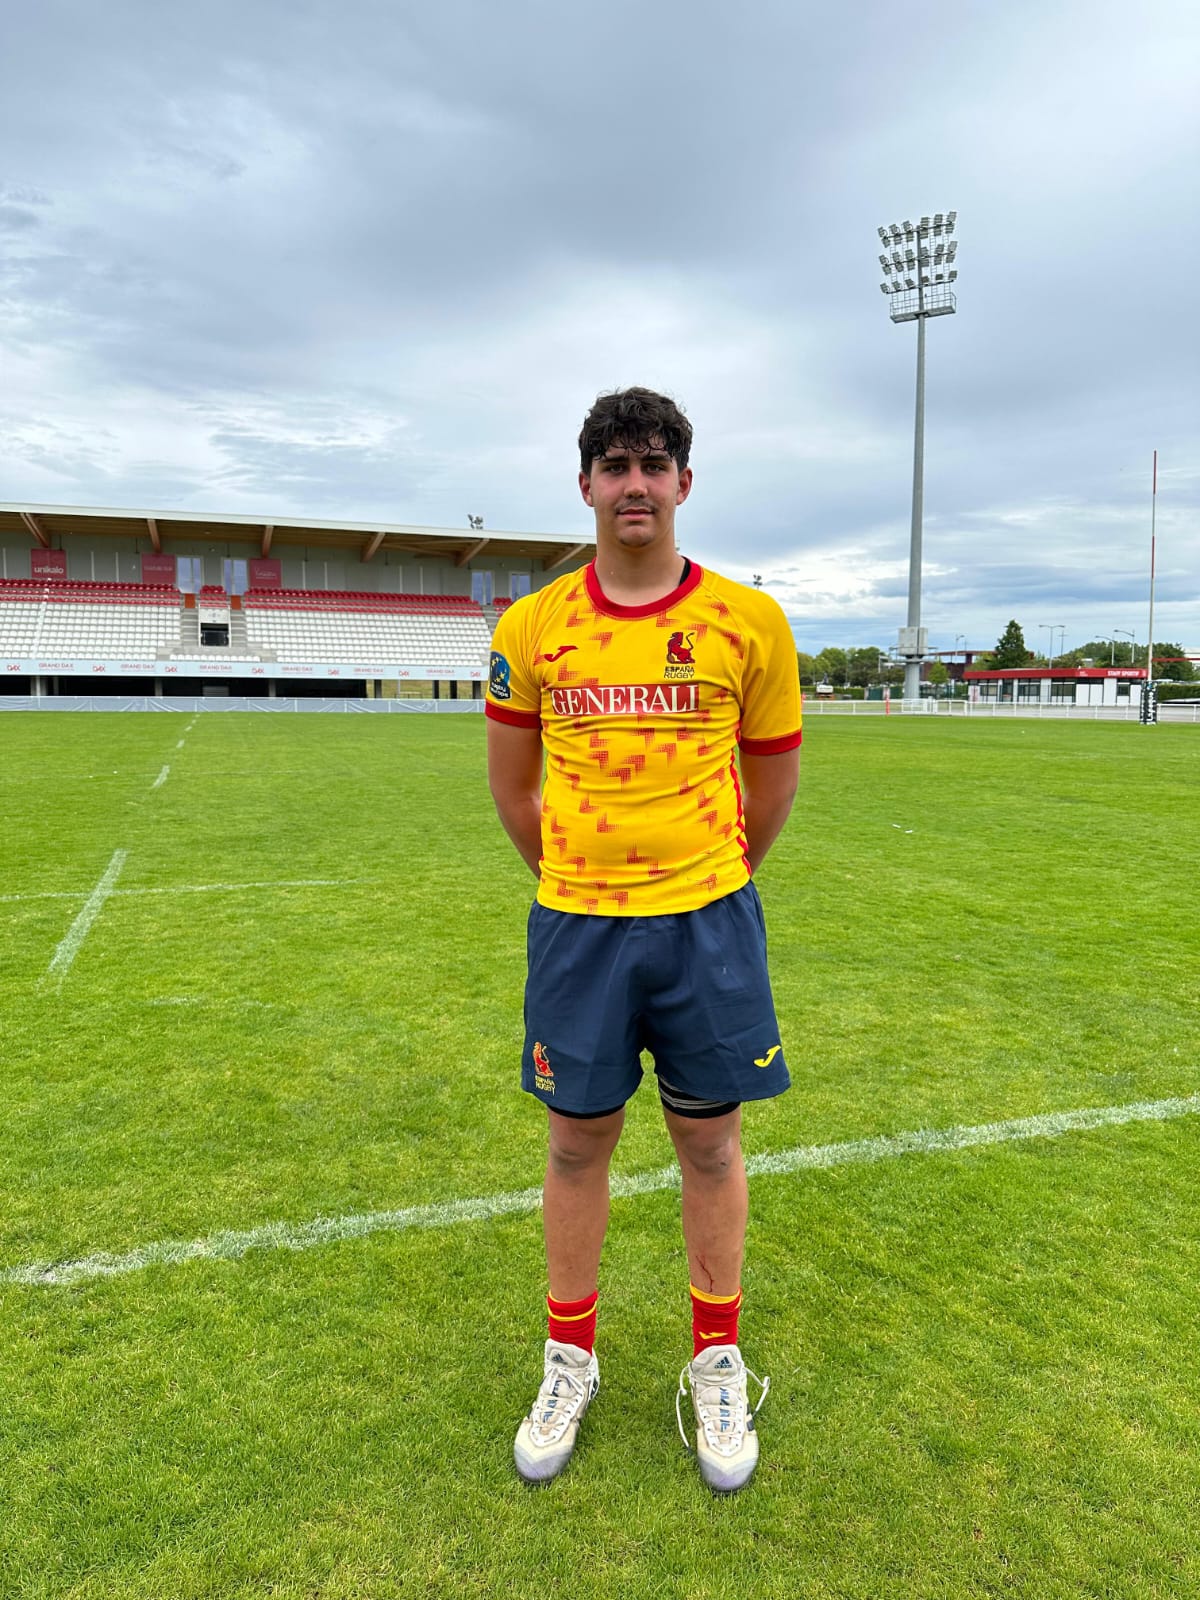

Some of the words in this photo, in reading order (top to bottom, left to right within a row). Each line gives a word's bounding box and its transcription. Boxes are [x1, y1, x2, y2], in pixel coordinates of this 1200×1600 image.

[34, 566, 64, 574] unikalo
[664, 665, 695, 673] ESPAÑA
[551, 684, 699, 715] GENERALI
[535, 1080, 555, 1096] RUGBY
